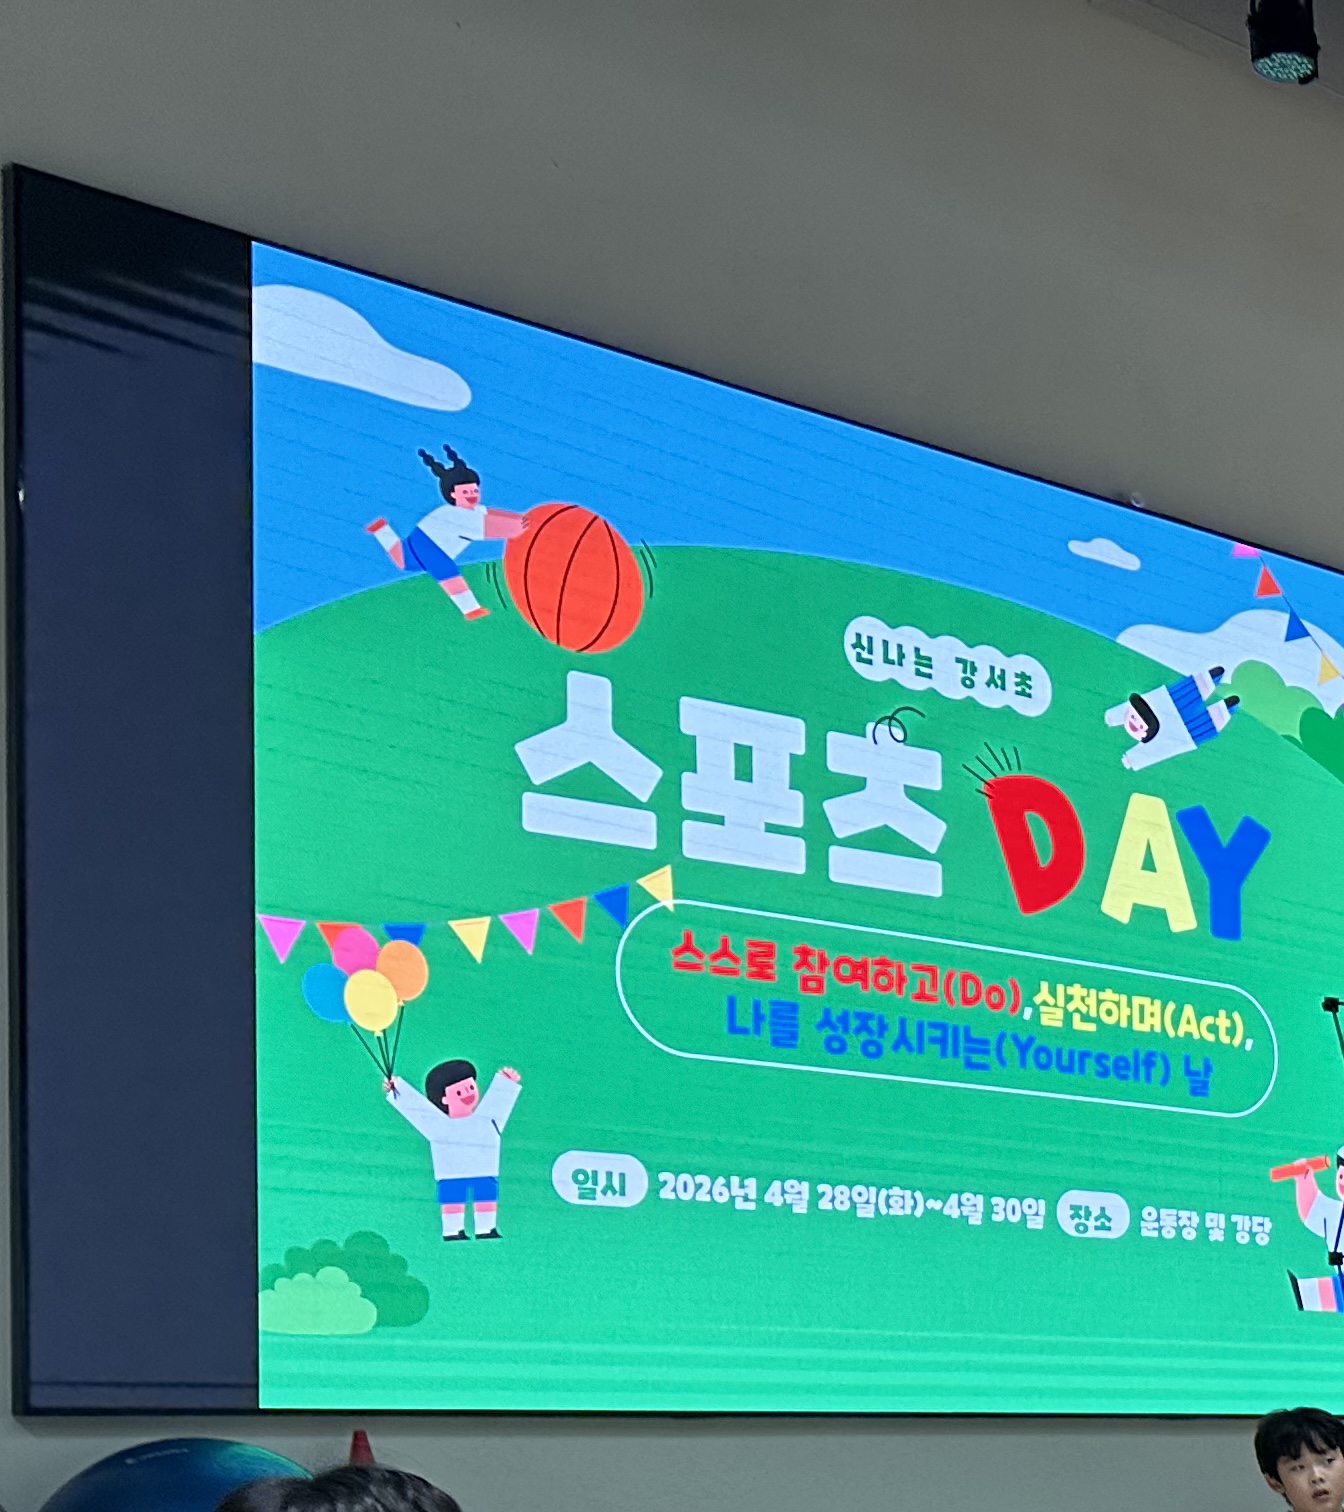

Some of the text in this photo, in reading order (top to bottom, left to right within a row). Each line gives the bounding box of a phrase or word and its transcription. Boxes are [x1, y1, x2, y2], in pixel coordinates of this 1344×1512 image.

[851, 632, 1033, 699] 신나는 강서초
[514, 670, 1272, 942] 스포츠 DAY
[671, 929, 777, 982] 스스로
[726, 994, 1213, 1098] 나를 성장시키는(Yourself) 날
[571, 1168, 626, 1201] 일시
[658, 1171, 757, 1211] 2026년
[764, 1179, 810, 1214] 4월
[990, 1196, 1046, 1230] 30일
[1069, 1204, 1112, 1234] 장소
[1140, 1205, 1272, 1246] 운동장 및 강당
